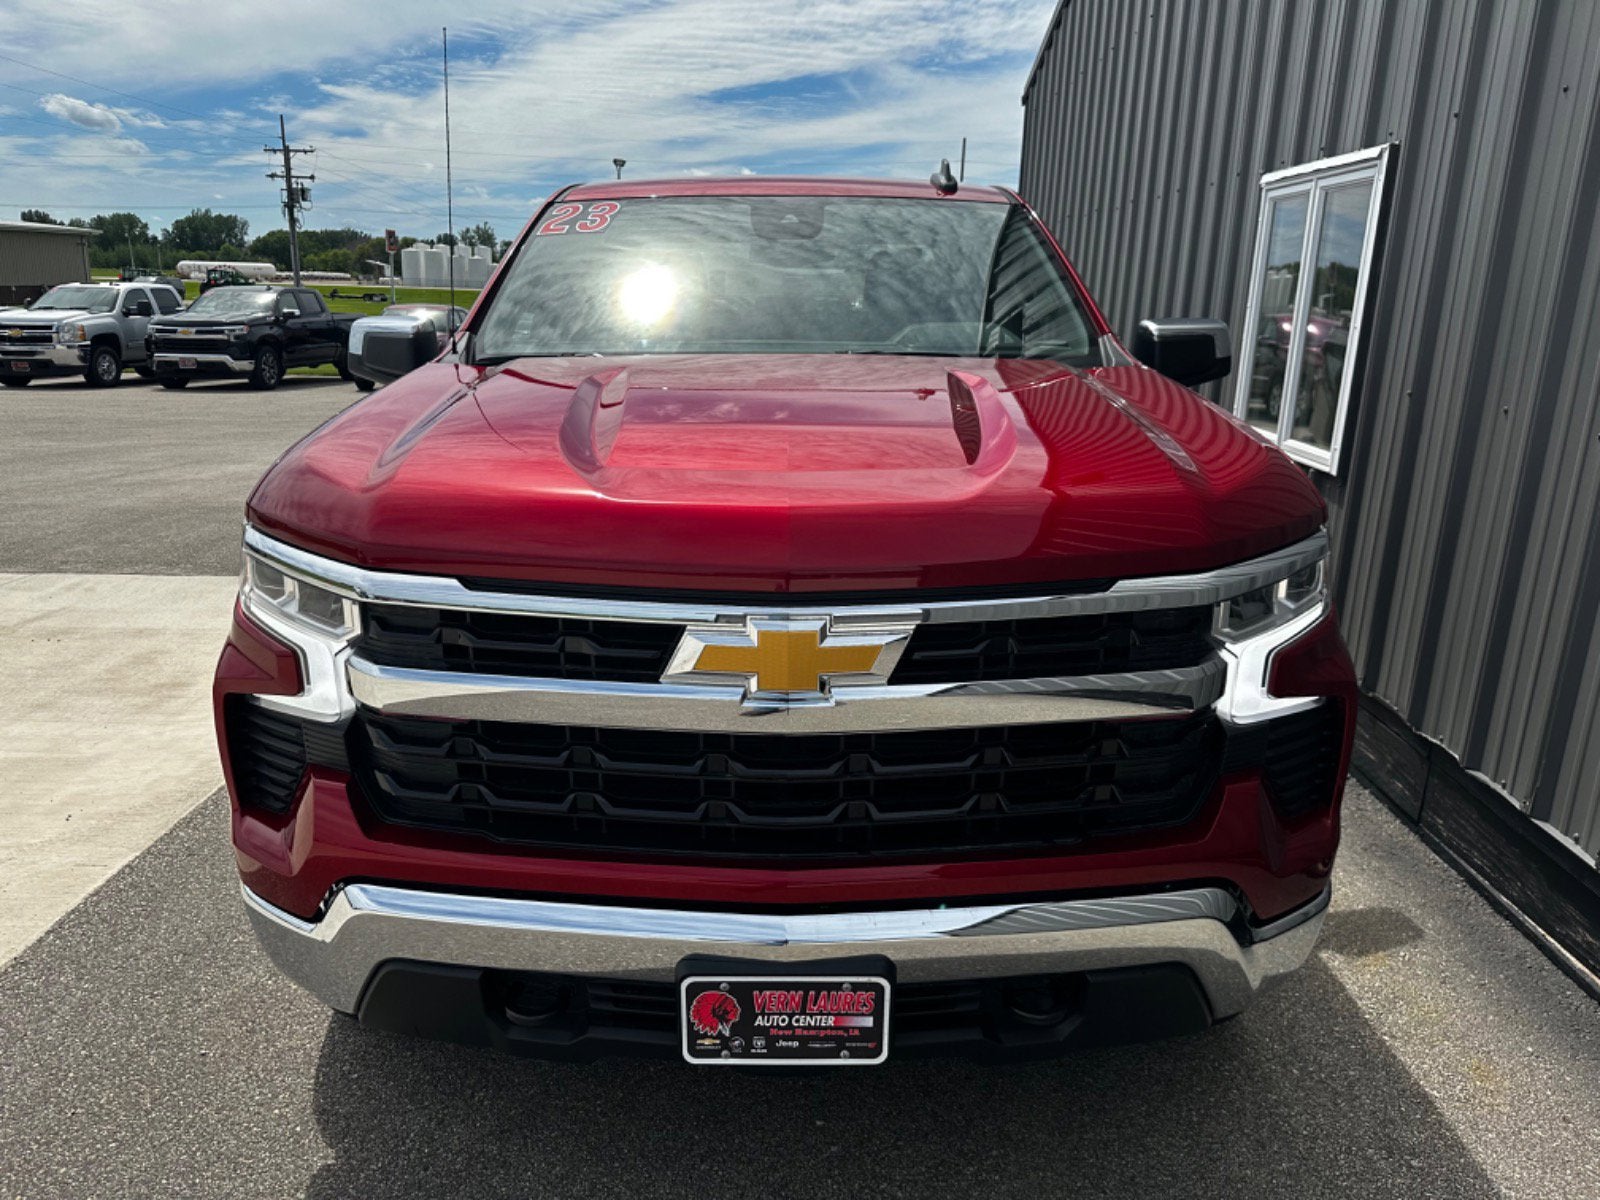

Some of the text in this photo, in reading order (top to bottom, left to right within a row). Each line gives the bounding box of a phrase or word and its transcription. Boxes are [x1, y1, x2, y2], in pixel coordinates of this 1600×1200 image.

[537, 201, 620, 235] 23
[753, 991, 876, 1014] VERN LAURES
[754, 1015, 835, 1027] AUTO CENTER
[769, 1028, 793, 1036] New
[775, 1039, 800, 1048] Jeep
